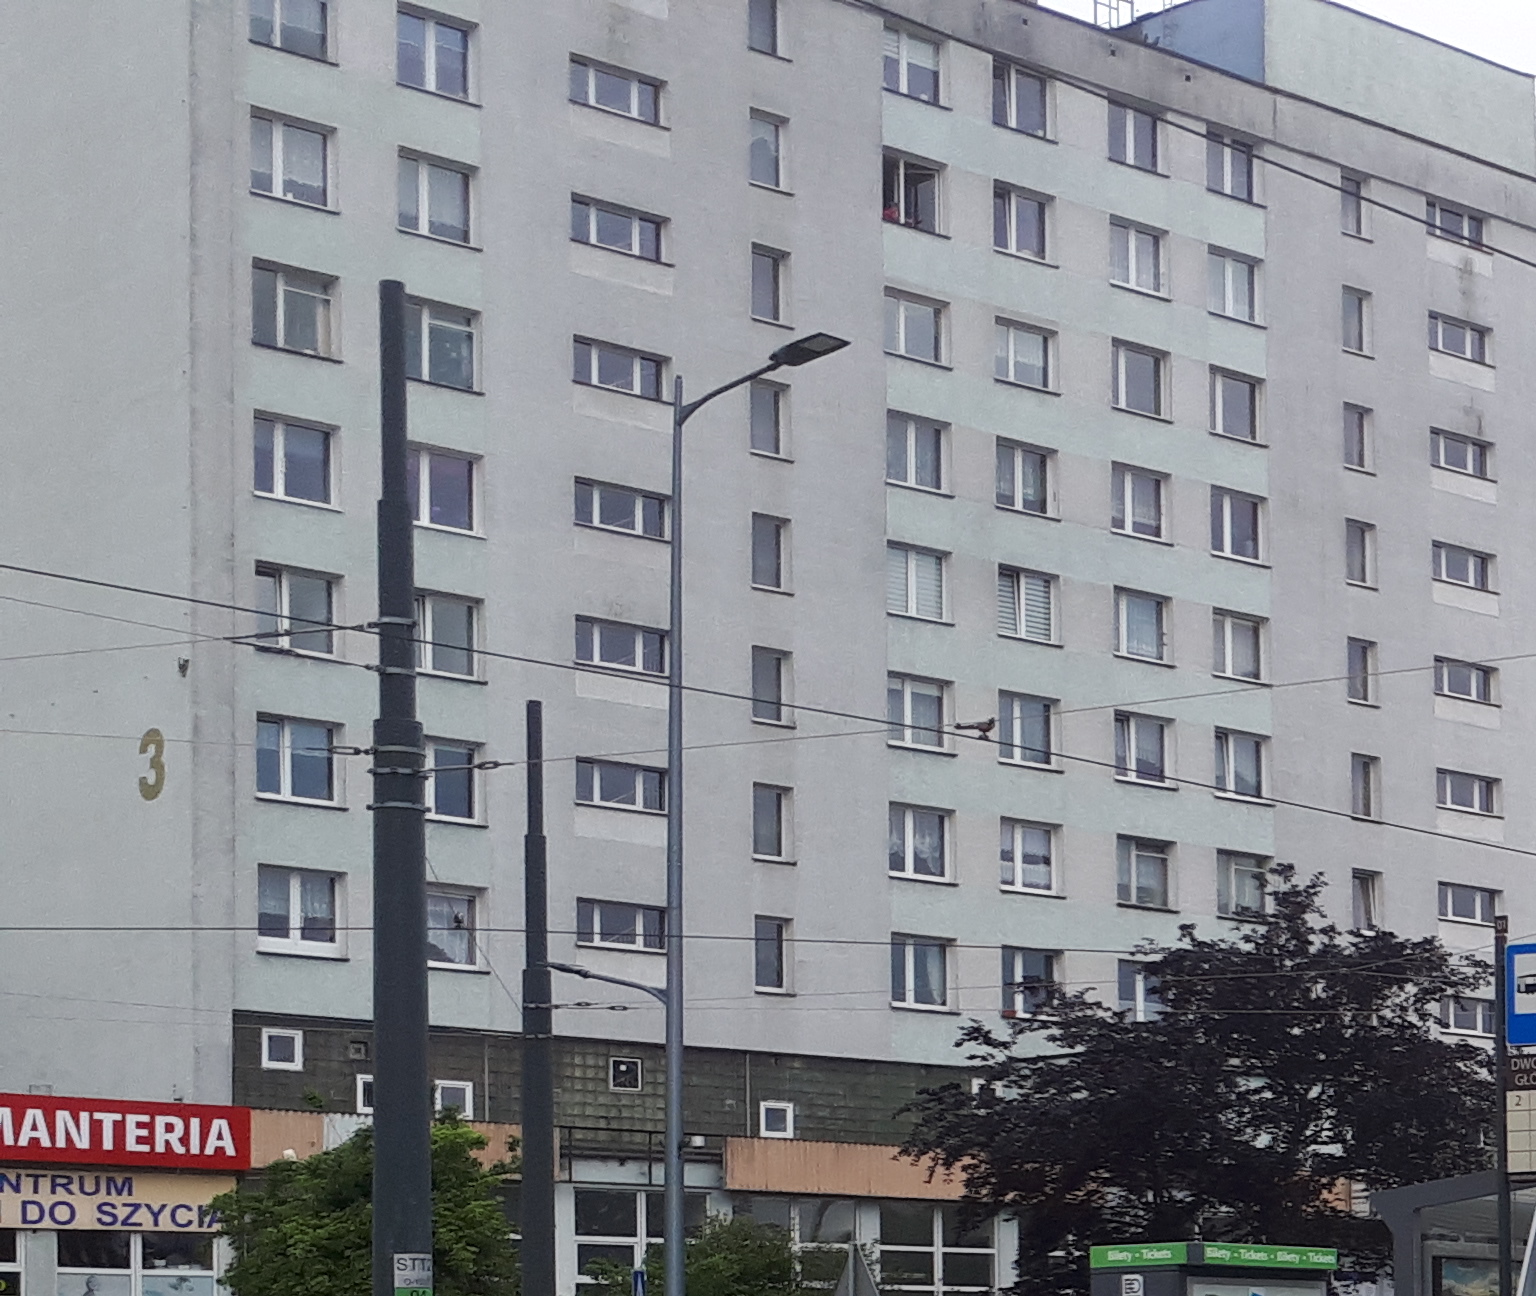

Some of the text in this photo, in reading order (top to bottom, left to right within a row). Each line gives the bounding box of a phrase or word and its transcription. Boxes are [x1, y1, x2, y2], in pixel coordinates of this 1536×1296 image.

[138, 728, 165, 801] 3
[1514, 1095, 1522, 1106] 2
[21, 1200, 77, 1226] DO
